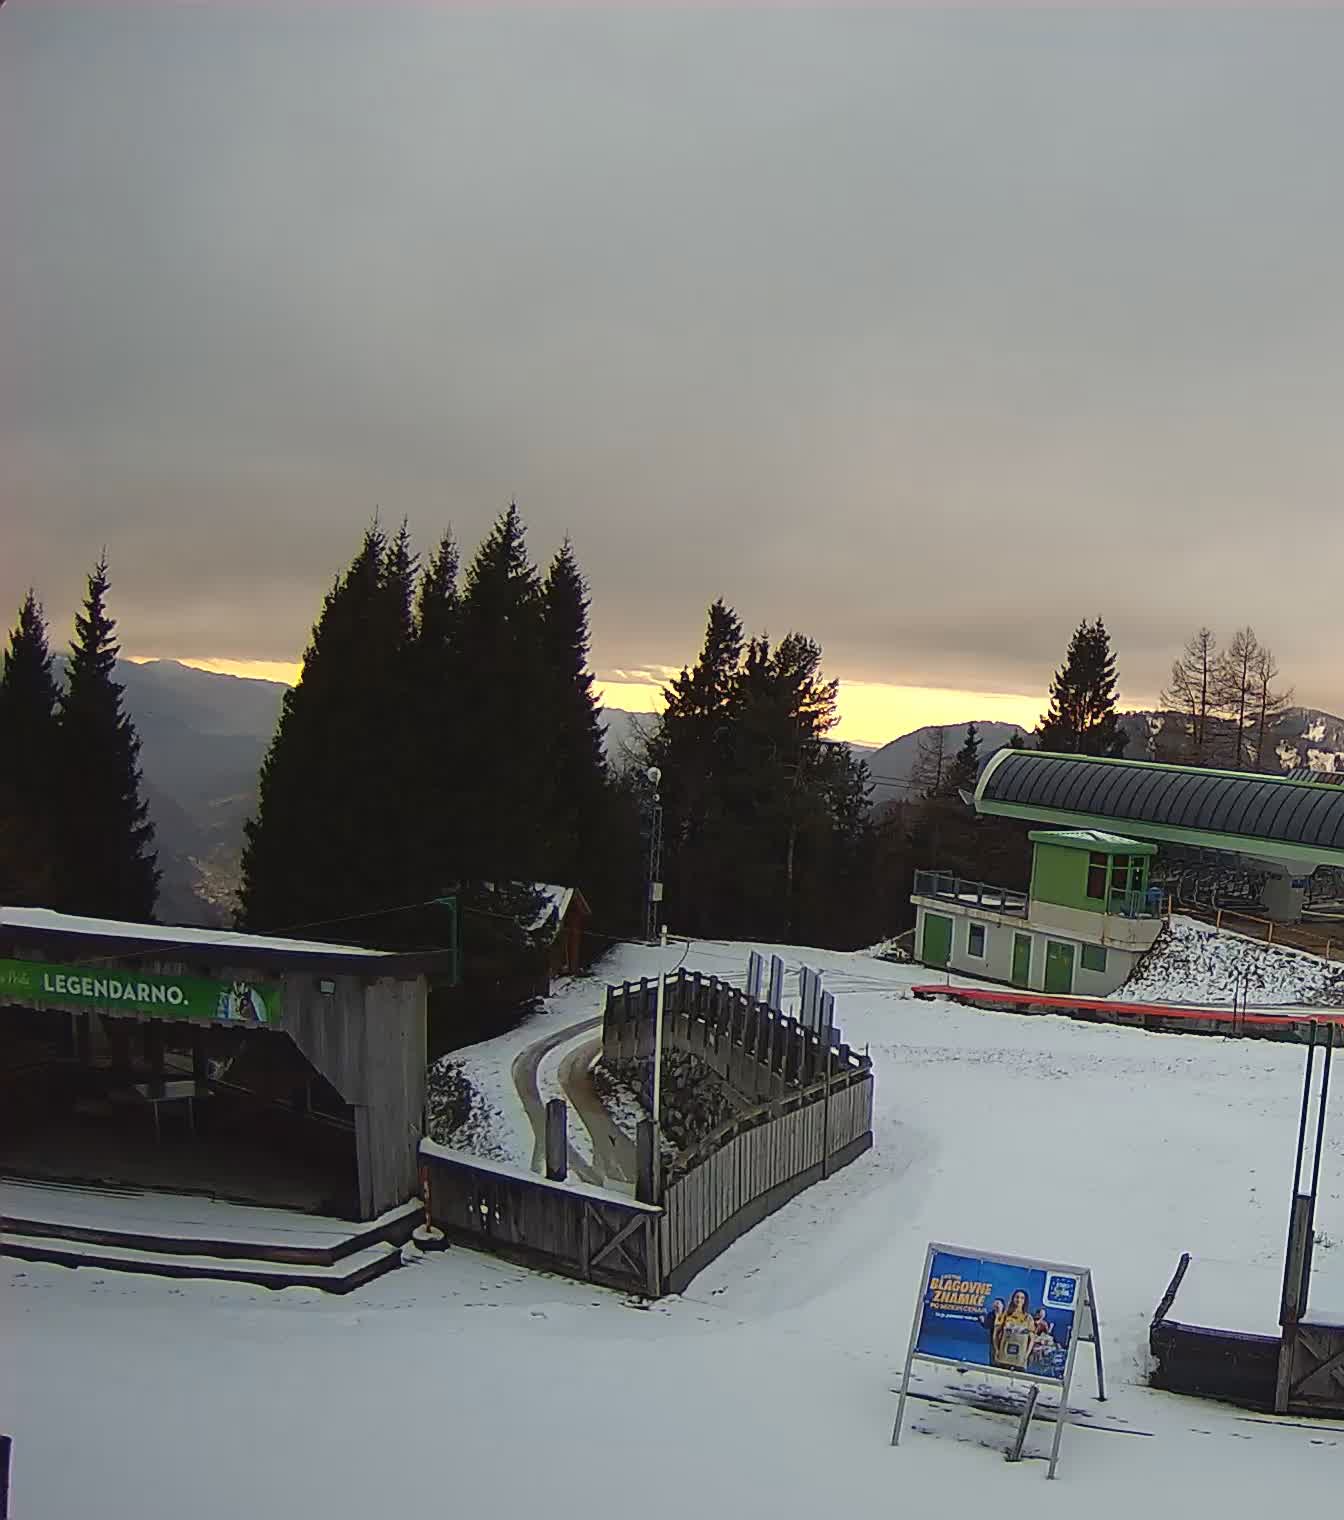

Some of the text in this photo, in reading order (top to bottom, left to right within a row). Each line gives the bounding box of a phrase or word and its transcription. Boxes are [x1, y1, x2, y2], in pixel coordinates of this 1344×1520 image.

[43, 973, 189, 1006] LEGENDARNO.
[930, 1277, 993, 1296] BLAGOVNE
[933, 1290, 986, 1306] ZNAMKE
